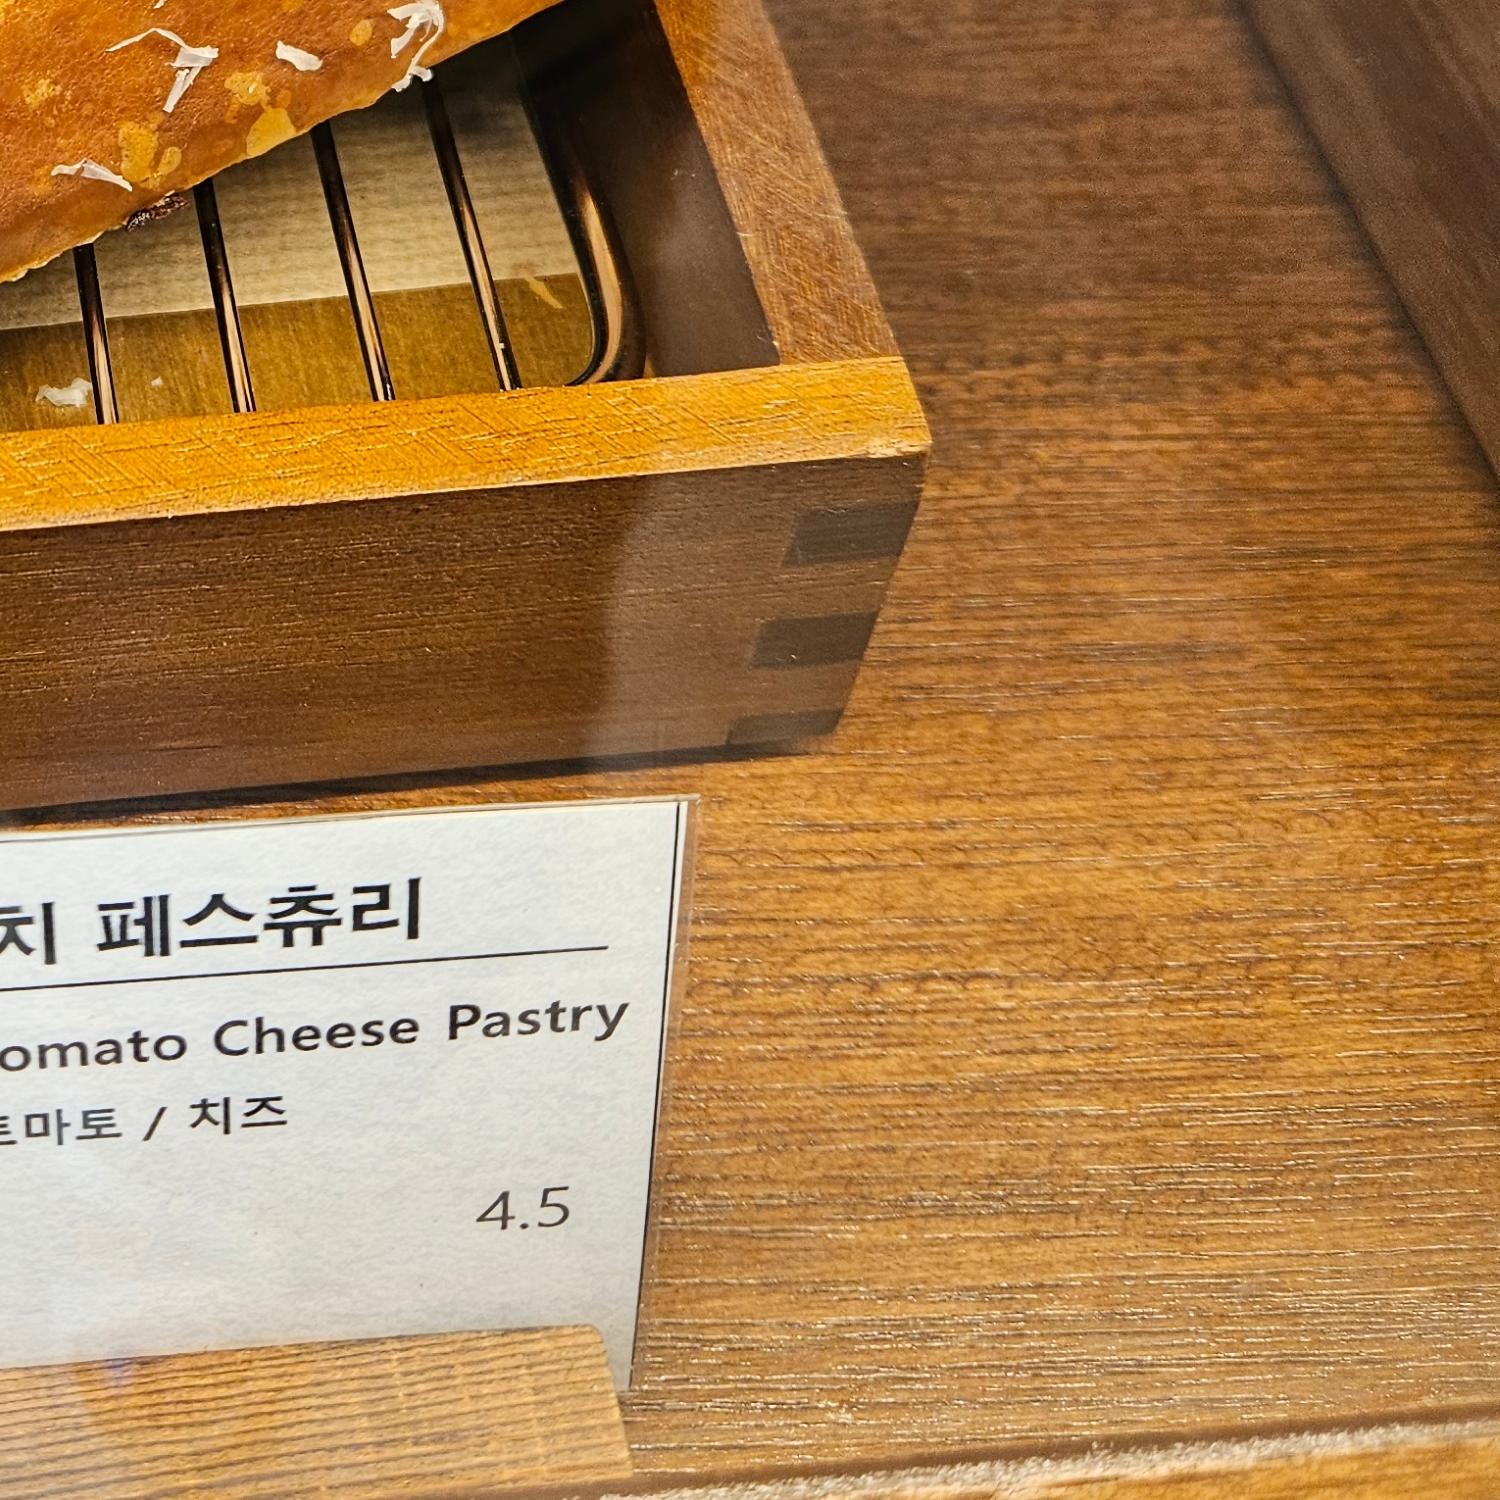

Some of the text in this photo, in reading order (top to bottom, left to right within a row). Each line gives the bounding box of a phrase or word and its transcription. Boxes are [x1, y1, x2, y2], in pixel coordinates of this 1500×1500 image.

[96, 876, 422, 958] 페스츄리
[213, 1015, 420, 1058] Cheese
[447, 995, 630, 1043] Pastry
[188, 1093, 289, 1136] 치즈
[475, 1185, 571, 1232] 4.5
